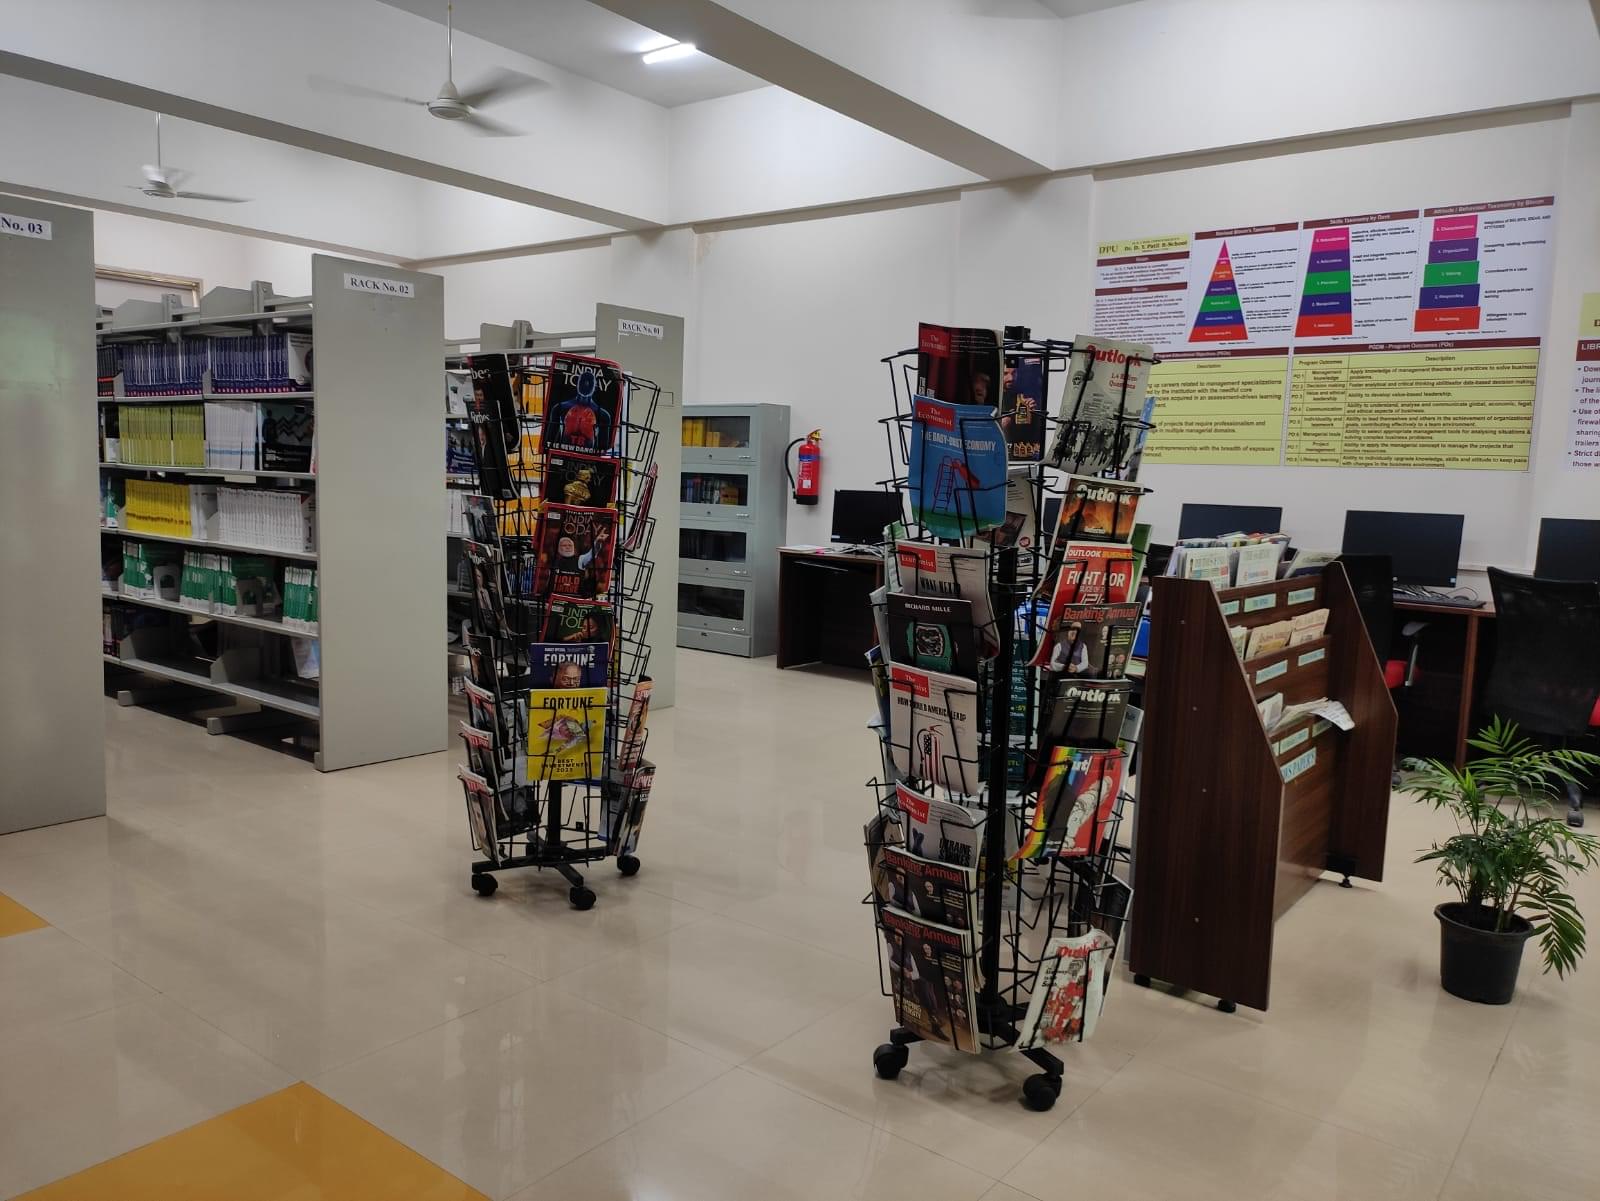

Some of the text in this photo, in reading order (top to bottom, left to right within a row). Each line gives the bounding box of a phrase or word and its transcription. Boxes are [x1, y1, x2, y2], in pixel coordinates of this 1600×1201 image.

[2, 216, 42, 234] No. 03
[350, 278, 409, 294] RACK No. 02
[622, 322, 640, 332] RACK
[572, 364, 604, 378] INDIA
[1582, 386, 1595, 394] The
[930, 407, 940, 416] The
[1579, 408, 1592, 416] Use
[918, 412, 952, 426] Economist
[964, 440, 996, 451] ECONOMY
[1574, 450, 1592, 458] Strict
[1572, 460, 1592, 468] those
[1076, 484, 1130, 505] Outlok
[1068, 550, 1101, 558] OUTLOOK
[904, 603, 930, 611] RICHARD
[1064, 606, 1136, 622] Banking Annual
[544, 654, 596, 666] FORTUNE
[906, 674, 916, 682] The
[544, 697, 594, 710] FORTUNE
[886, 850, 962, 882] Banking Annual
[924, 928, 960, 946] Annual
